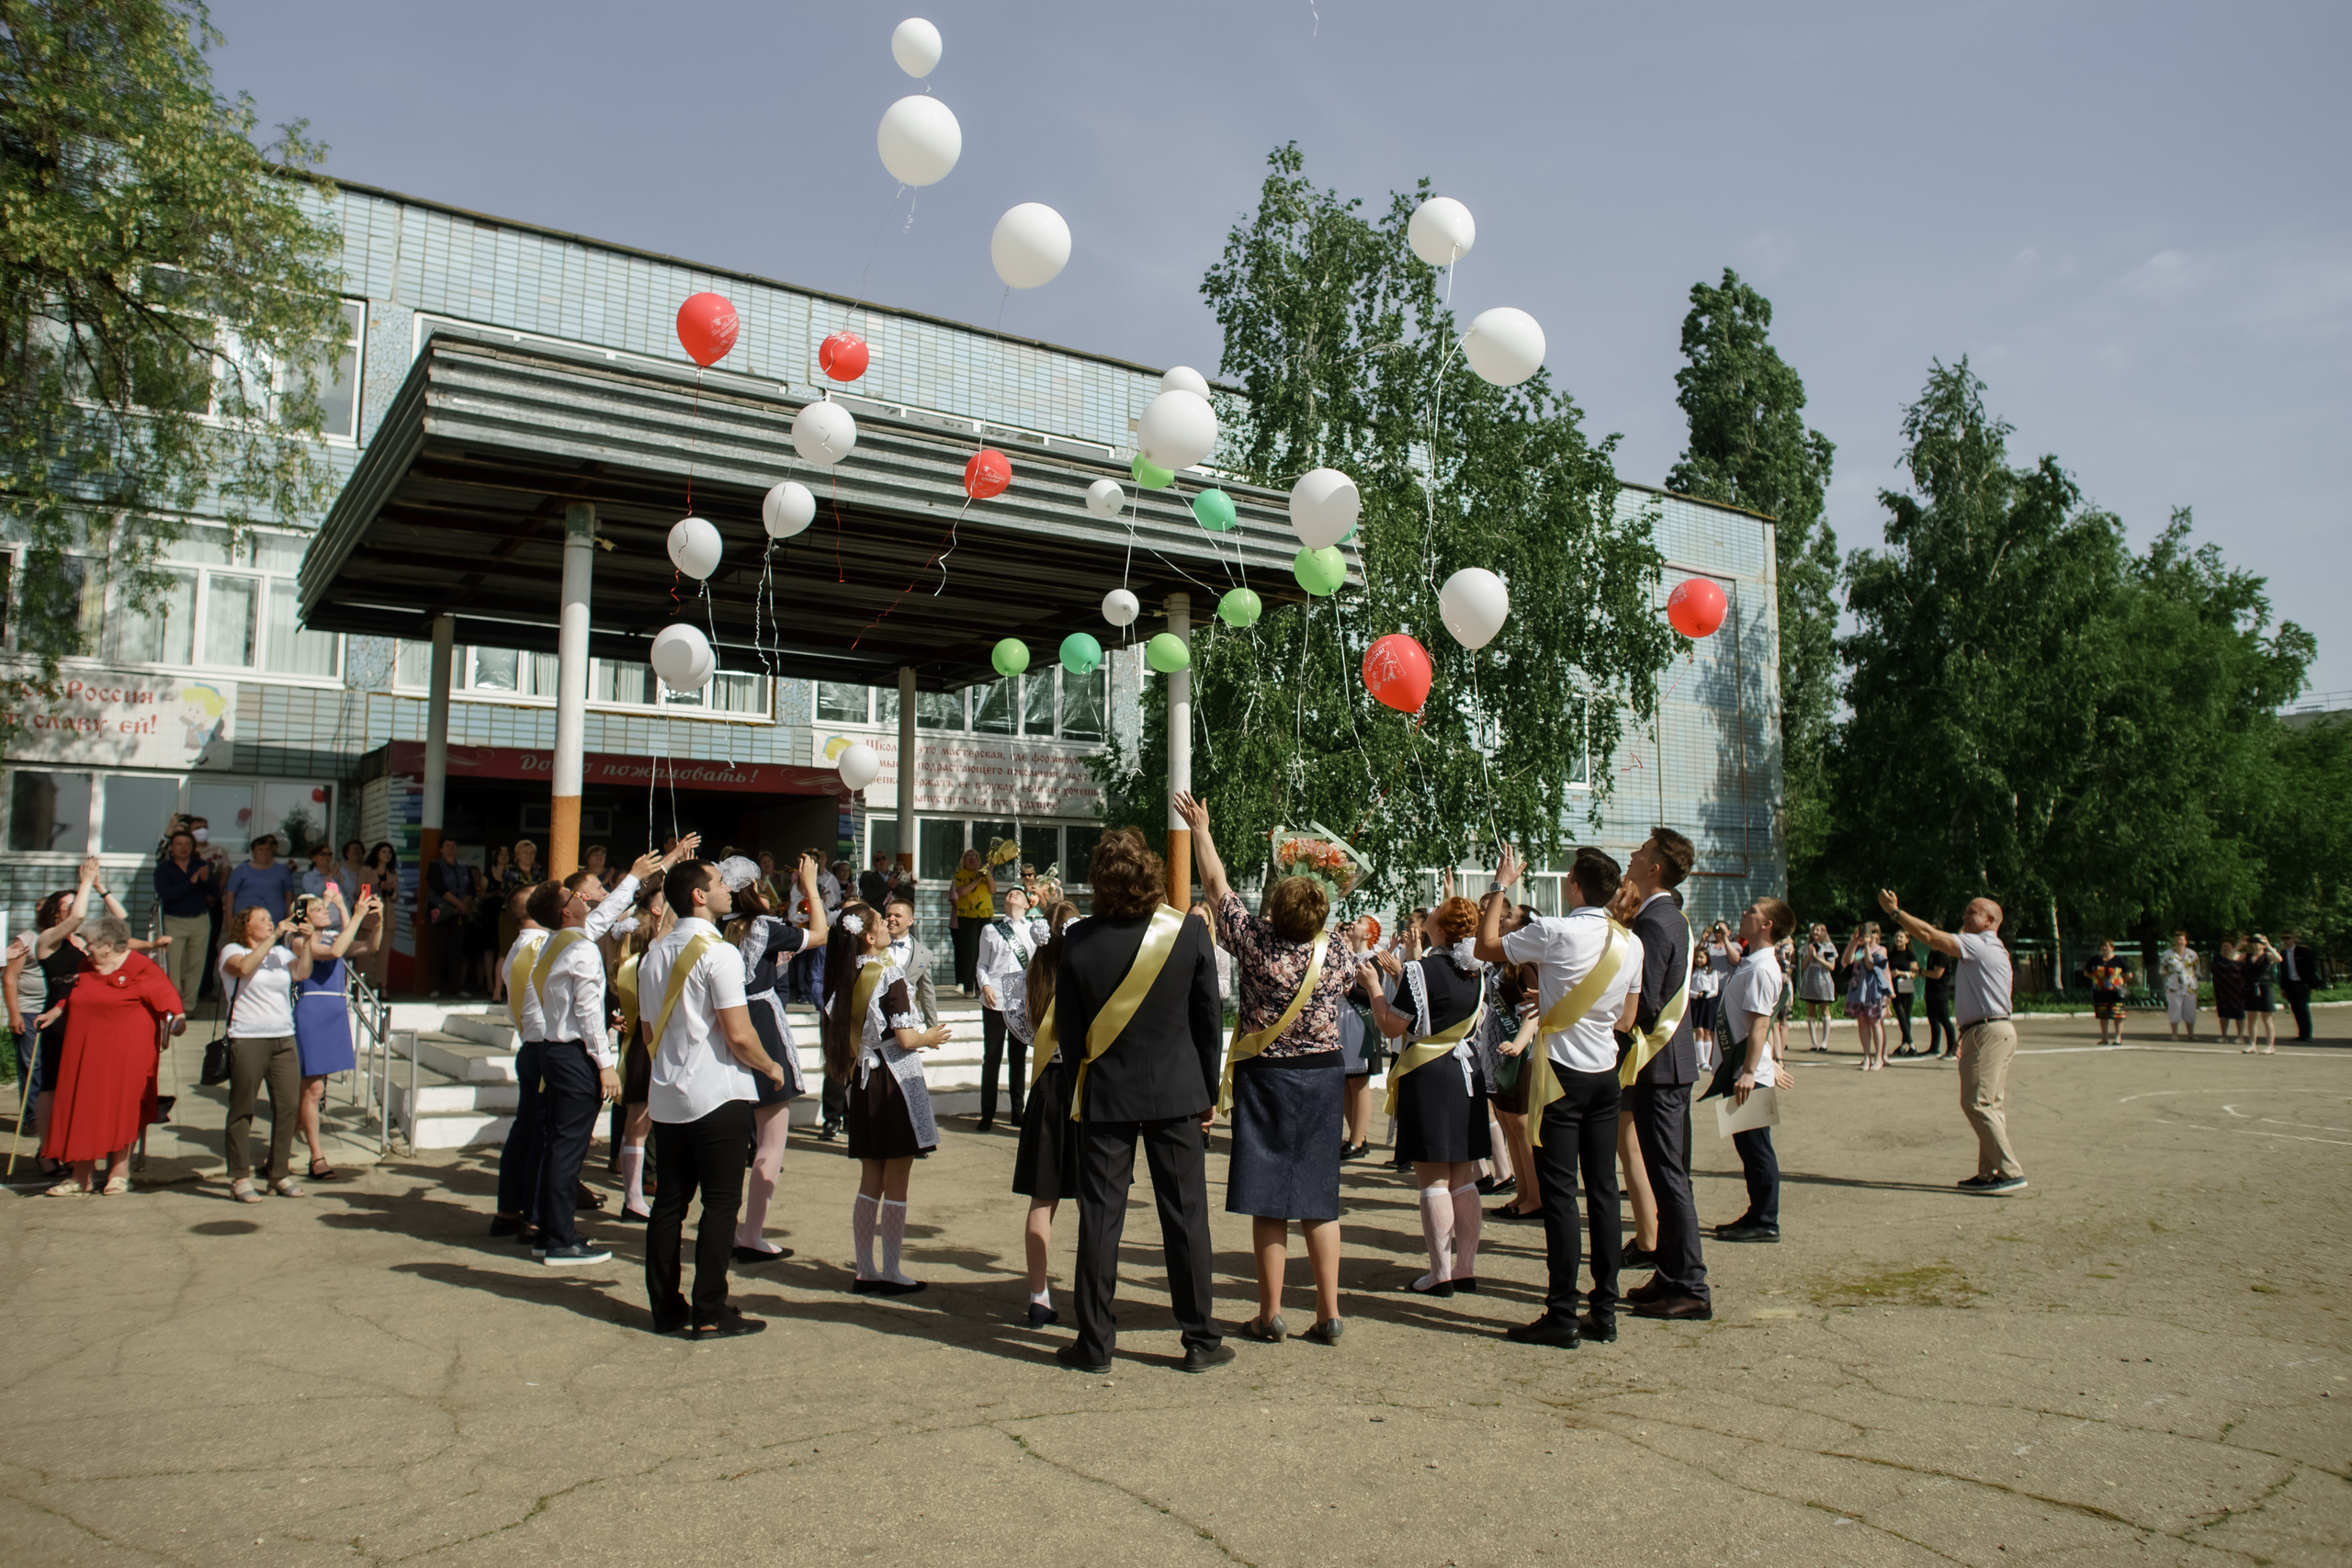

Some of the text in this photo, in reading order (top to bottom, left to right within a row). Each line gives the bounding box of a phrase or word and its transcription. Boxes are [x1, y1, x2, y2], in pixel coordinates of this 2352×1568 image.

[66, 680, 153, 705] Россия
[33, 714, 107, 739] славу
[119, 714, 157, 735] ей!
[865, 739, 898, 752] Школ
[917, 746, 936, 755] это
[941, 748, 1006, 761] мастерская,
[1031, 752, 1080, 768] формируе
[519, 753, 759, 784] Доо пожаловать!
[918, 761, 1003, 774] подрастающего
[1007, 768, 1061, 780] поколения,
[1065, 773, 1088, 782] надо
[914, 778, 954, 789] ержать
[1021, 785, 1044, 794] если
[1063, 786, 1100, 798] хочешь
[914, 794, 970, 807] ыпустить
[991, 798, 1009, 809] рук
[1500, 1015, 1519, 1034] 2021
[1718, 1029, 1731, 1051] 2021
